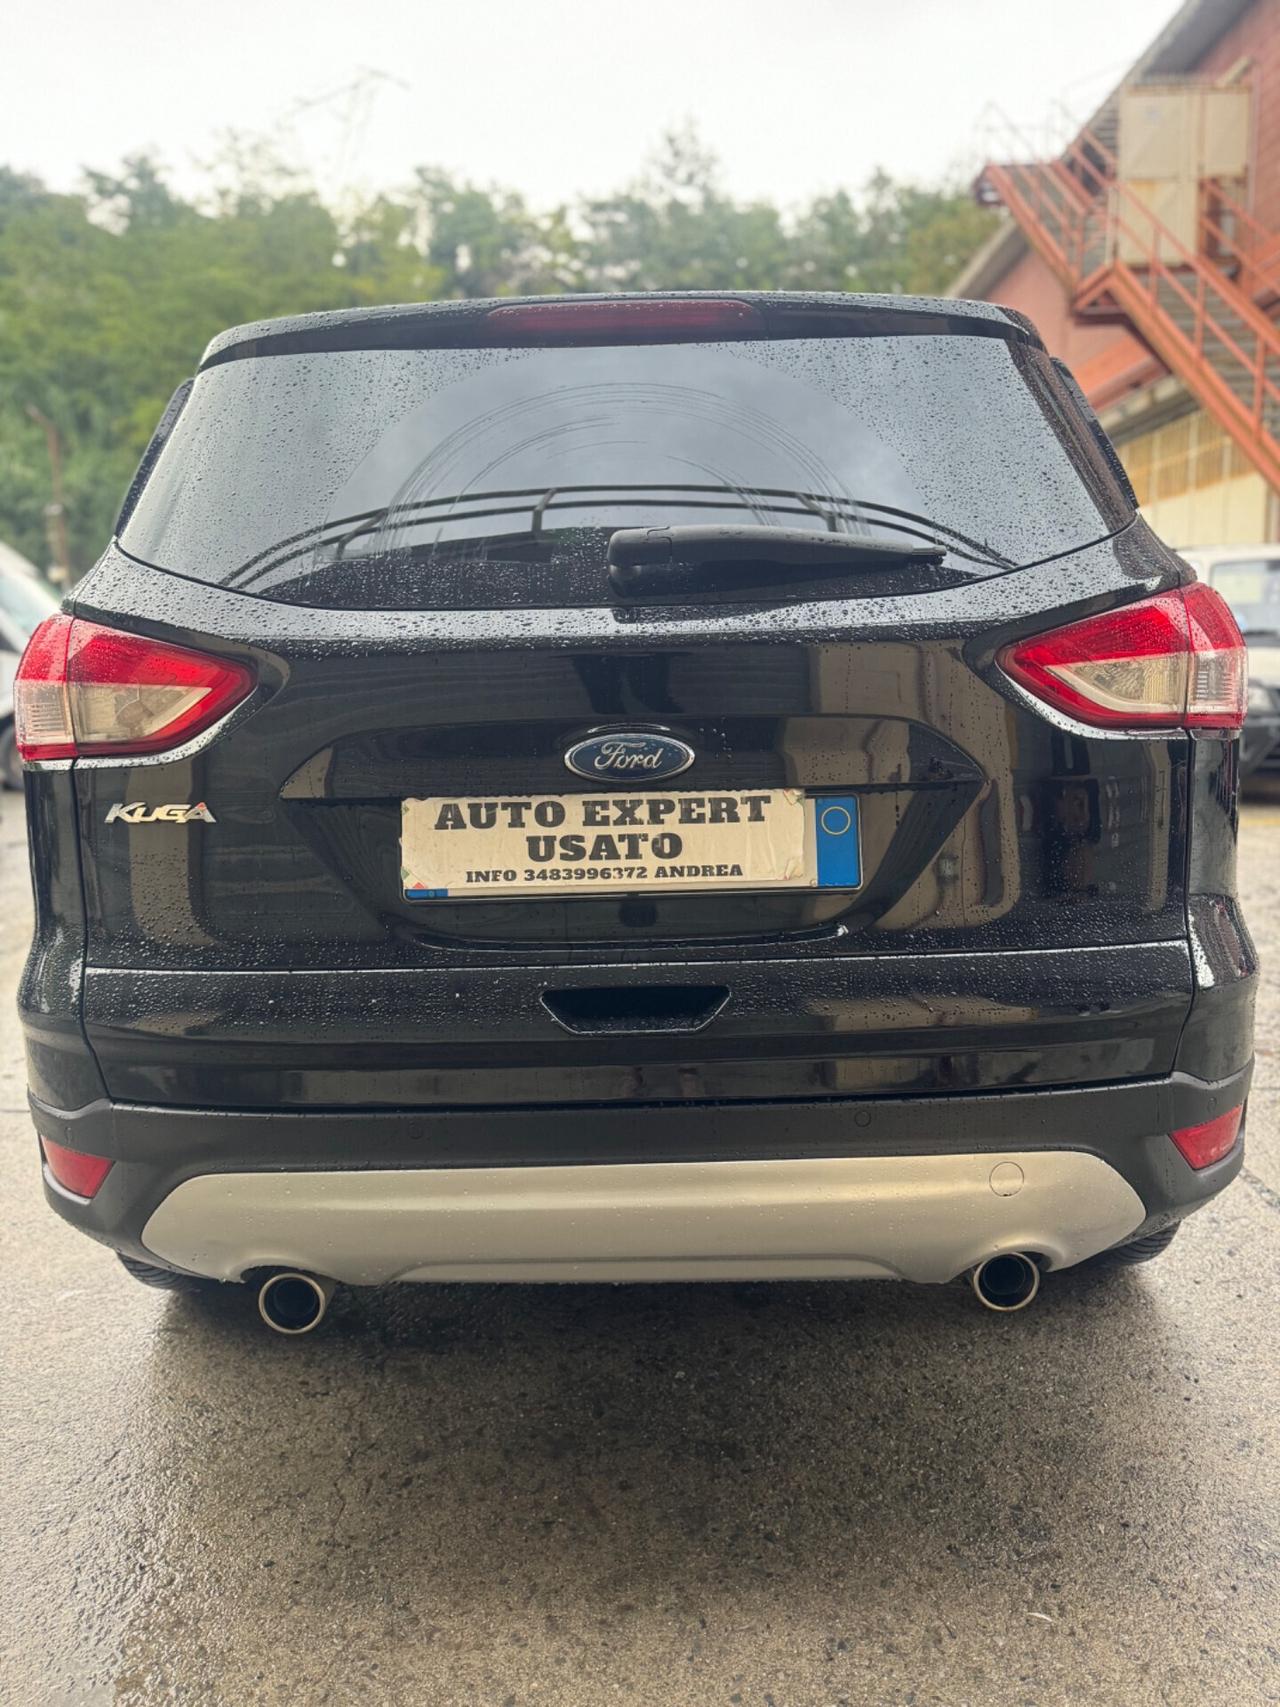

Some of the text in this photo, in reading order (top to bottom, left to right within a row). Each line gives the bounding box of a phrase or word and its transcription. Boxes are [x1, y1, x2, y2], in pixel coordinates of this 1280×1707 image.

[594, 741, 662, 770] Ford
[104, 801, 217, 824] KUGA
[434, 795, 771, 830] AUTO EXPERT
[526, 832, 683, 862] USATO
[465, 863, 743, 883] INFO 3483996372 ANDREA
